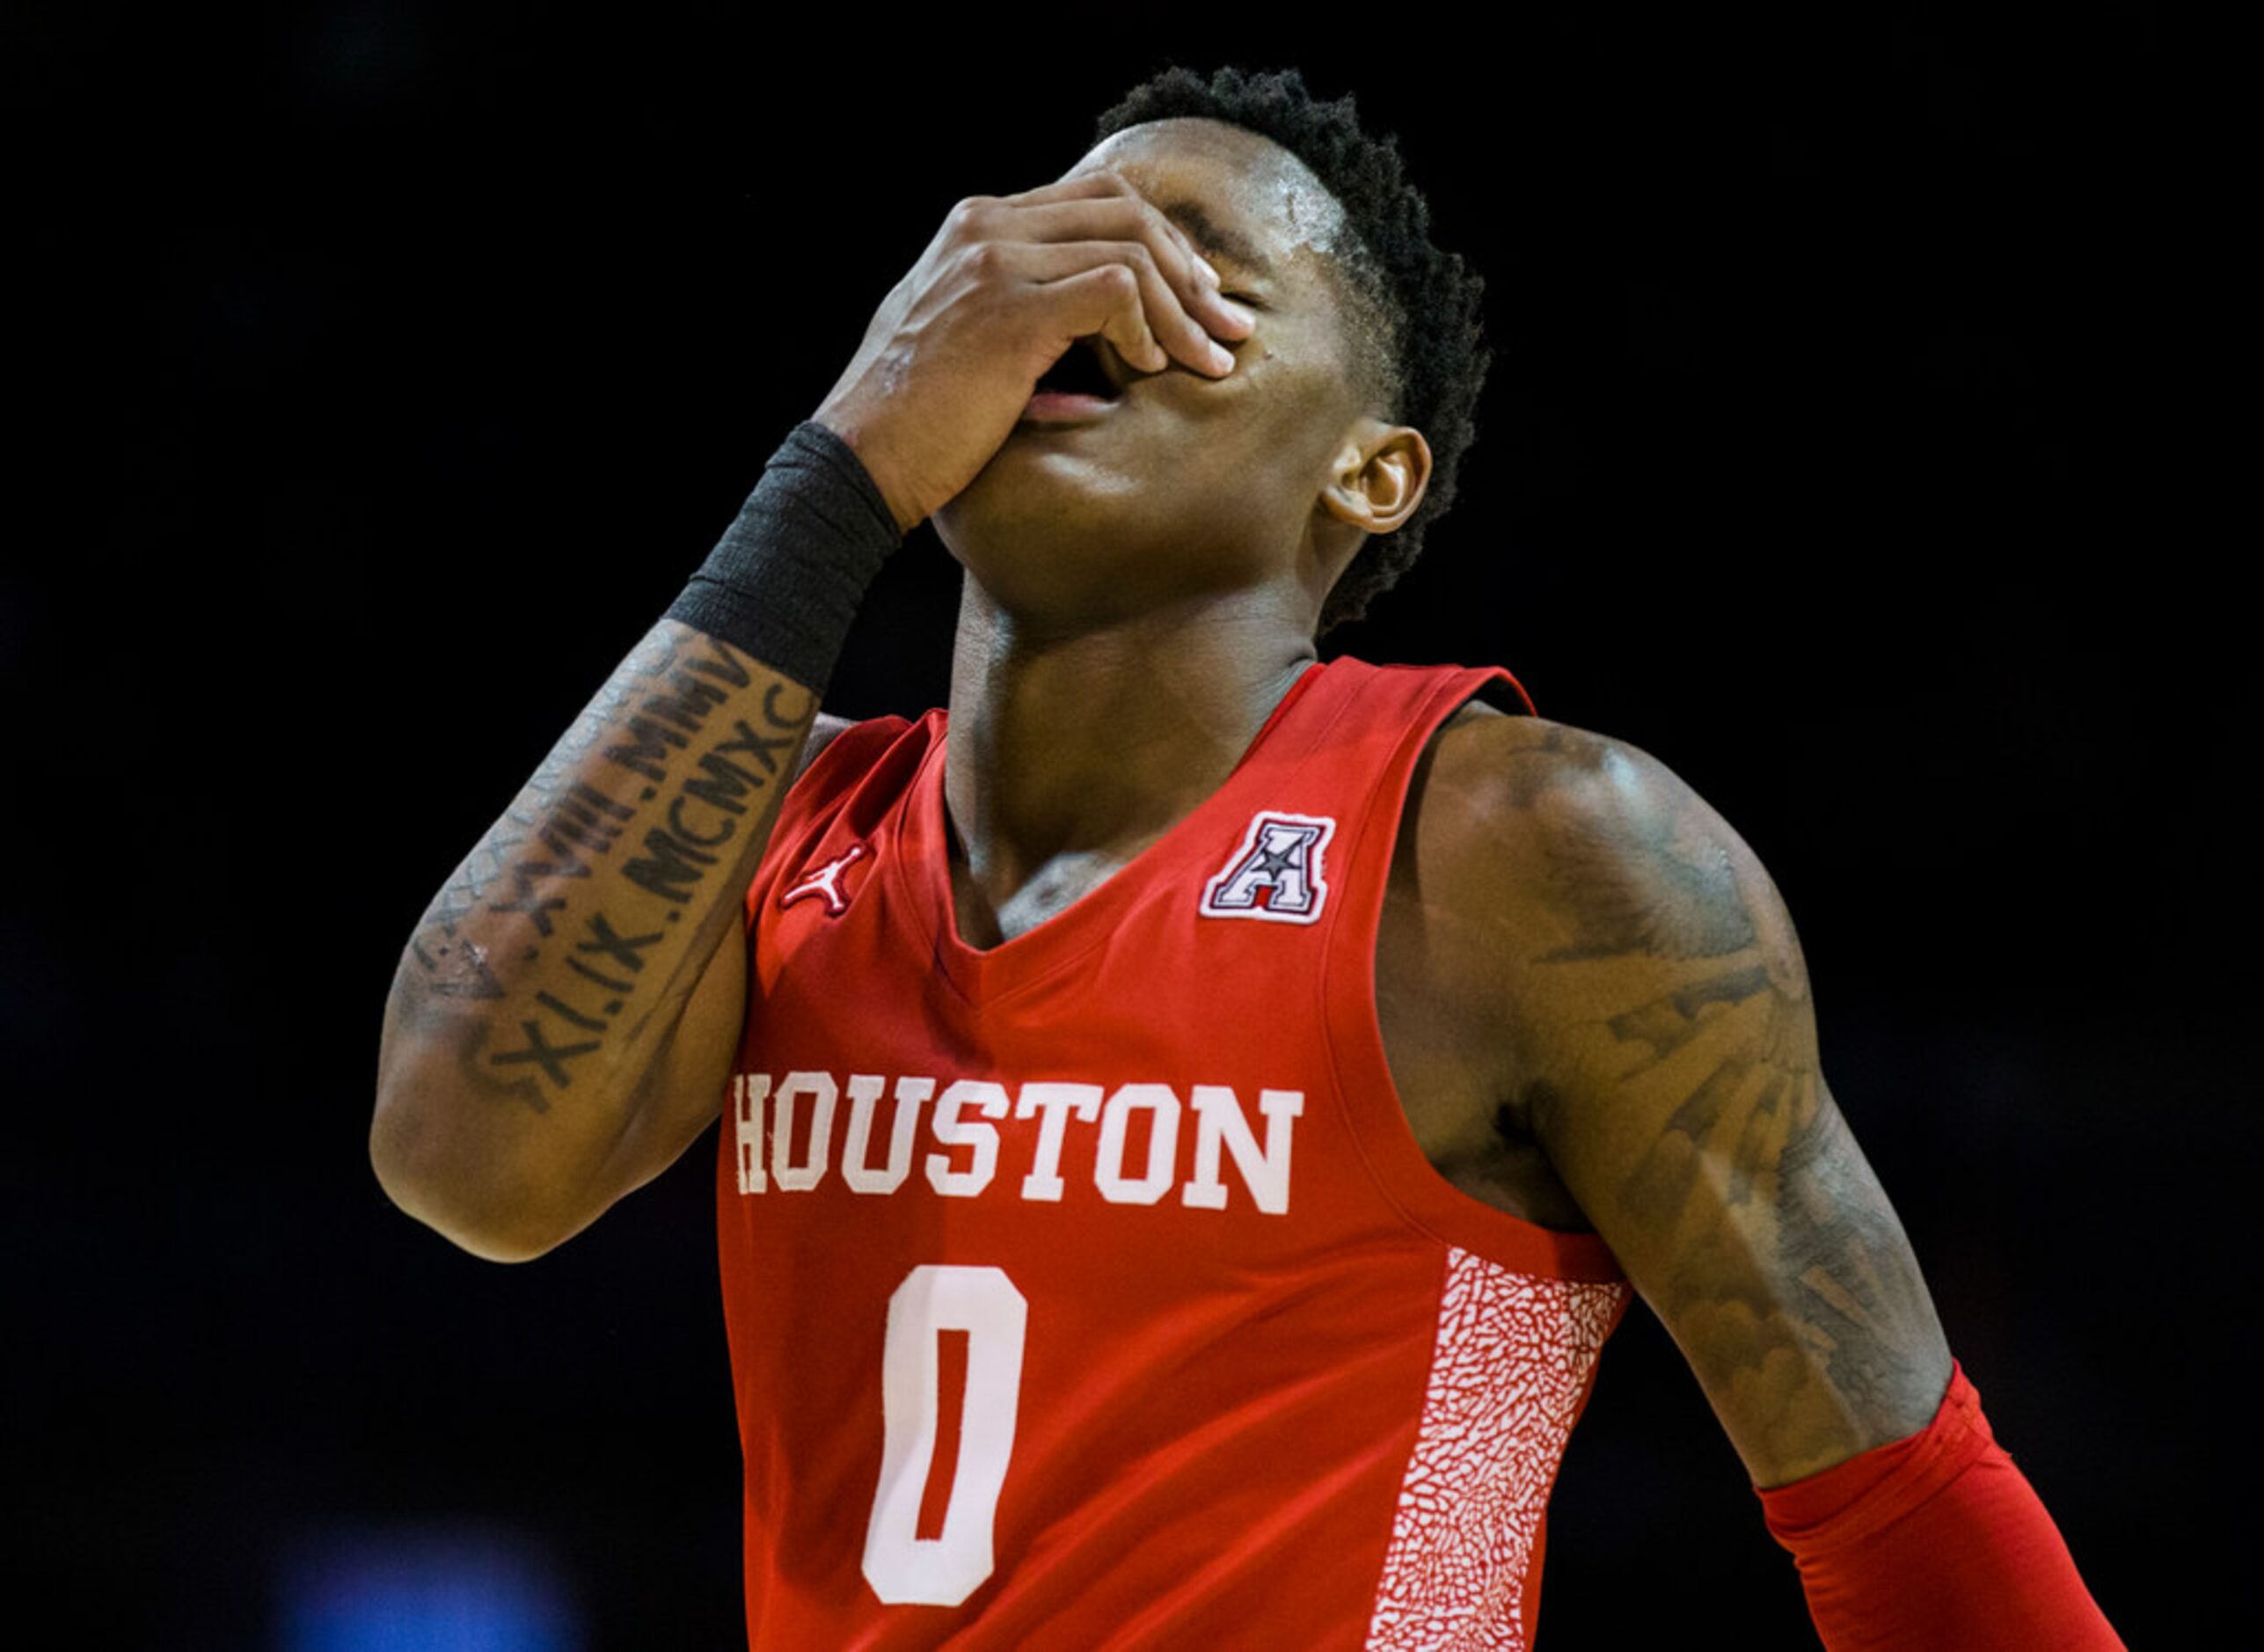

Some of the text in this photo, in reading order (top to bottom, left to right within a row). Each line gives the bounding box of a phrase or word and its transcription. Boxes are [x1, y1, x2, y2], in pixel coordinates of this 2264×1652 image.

[1204, 814, 1332, 921] A
[734, 1071, 1304, 1215] HOUSTON
[861, 1264, 1029, 1607] 0
